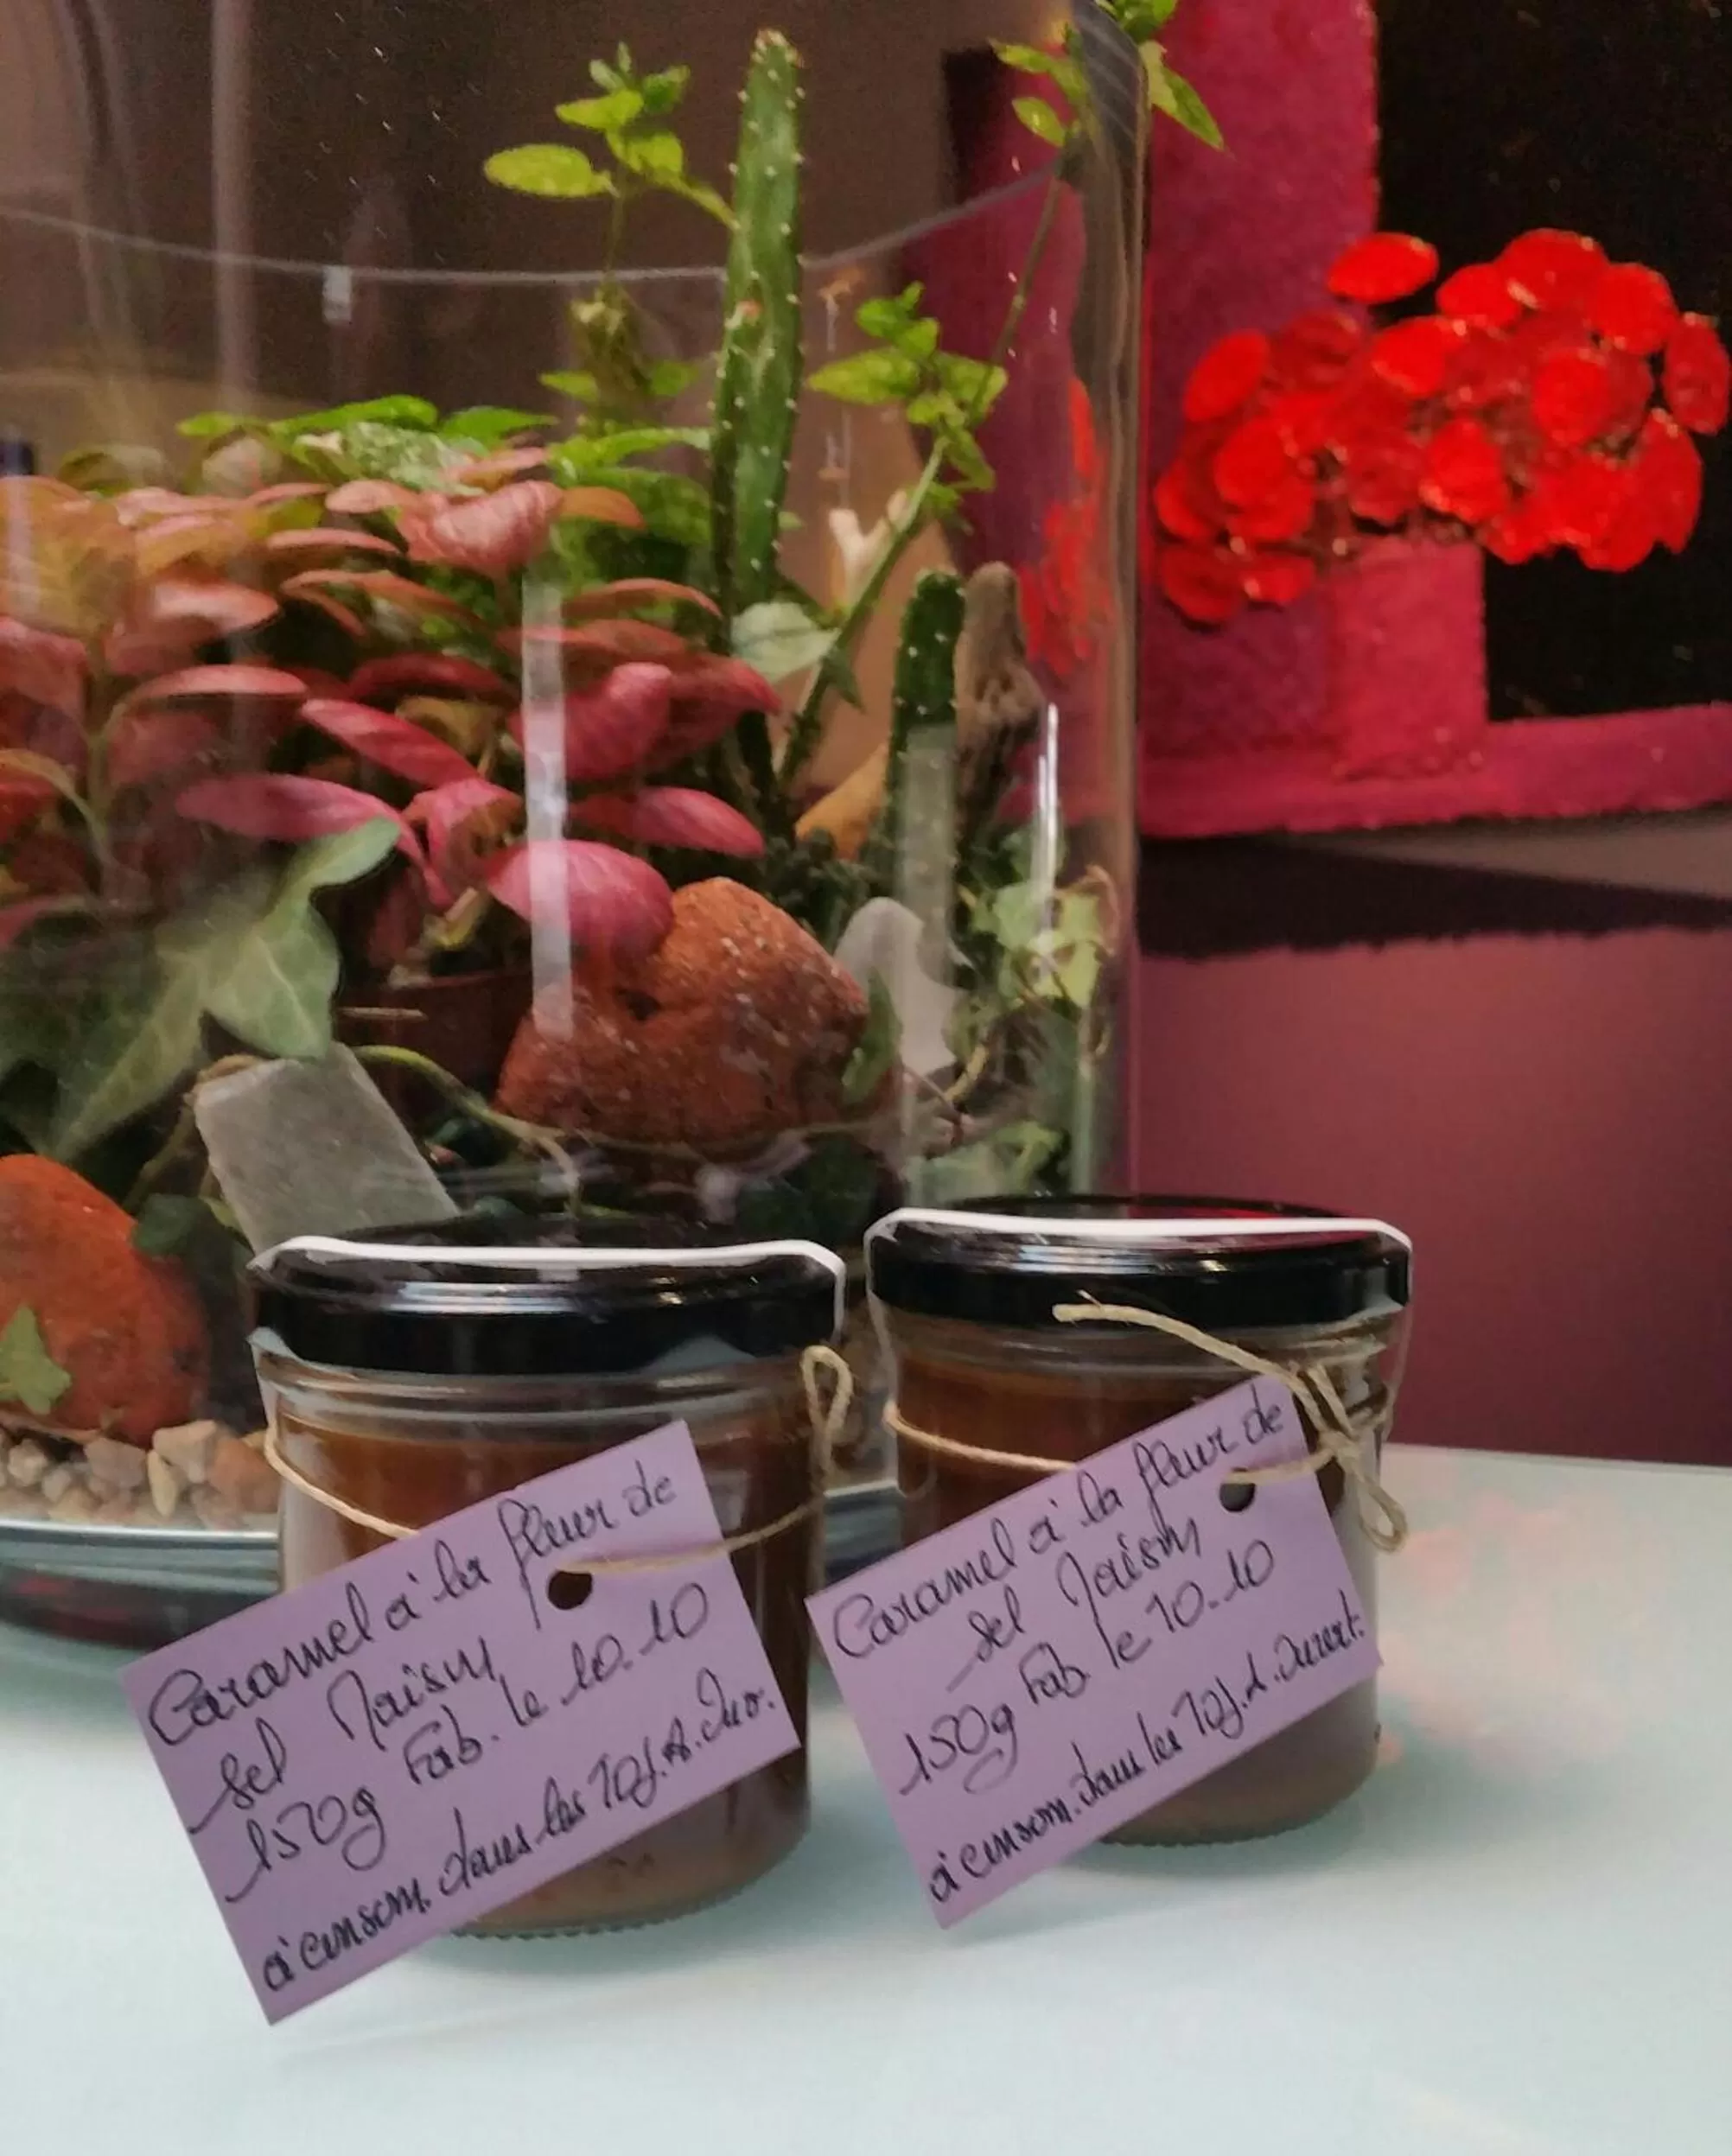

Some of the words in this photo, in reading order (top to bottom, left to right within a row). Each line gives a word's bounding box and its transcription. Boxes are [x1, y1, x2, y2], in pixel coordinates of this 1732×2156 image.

[148, 1582, 373, 1744] Caramel
[386, 1573, 420, 1631] à
[432, 1539, 489, 1600] la
[498, 1497, 616, 1630] fleur
[628, 1460, 677, 1517] de
[832, 1517, 1017, 1658] Caramel
[1029, 1497, 1066, 1554] à
[1079, 1472, 1124, 1527] la
[1132, 1436, 1238, 1533] fleur
[1245, 1383, 1283, 1446] de
[1056, 1519, 1202, 1625] Maison
[188, 1717, 286, 1835] sel
[328, 1637, 494, 1750] Maison
[225, 1787, 386, 1901] 150g
[498, 1669, 546, 1726] le
[899, 1701, 1018, 1795] 150g
[1098, 1616, 1153, 1669] le
[263, 1936, 295, 1991] à
[438, 1807, 531, 1896] dans
[928, 1850, 958, 1904] à
[1136, 1713, 1183, 1767] les
